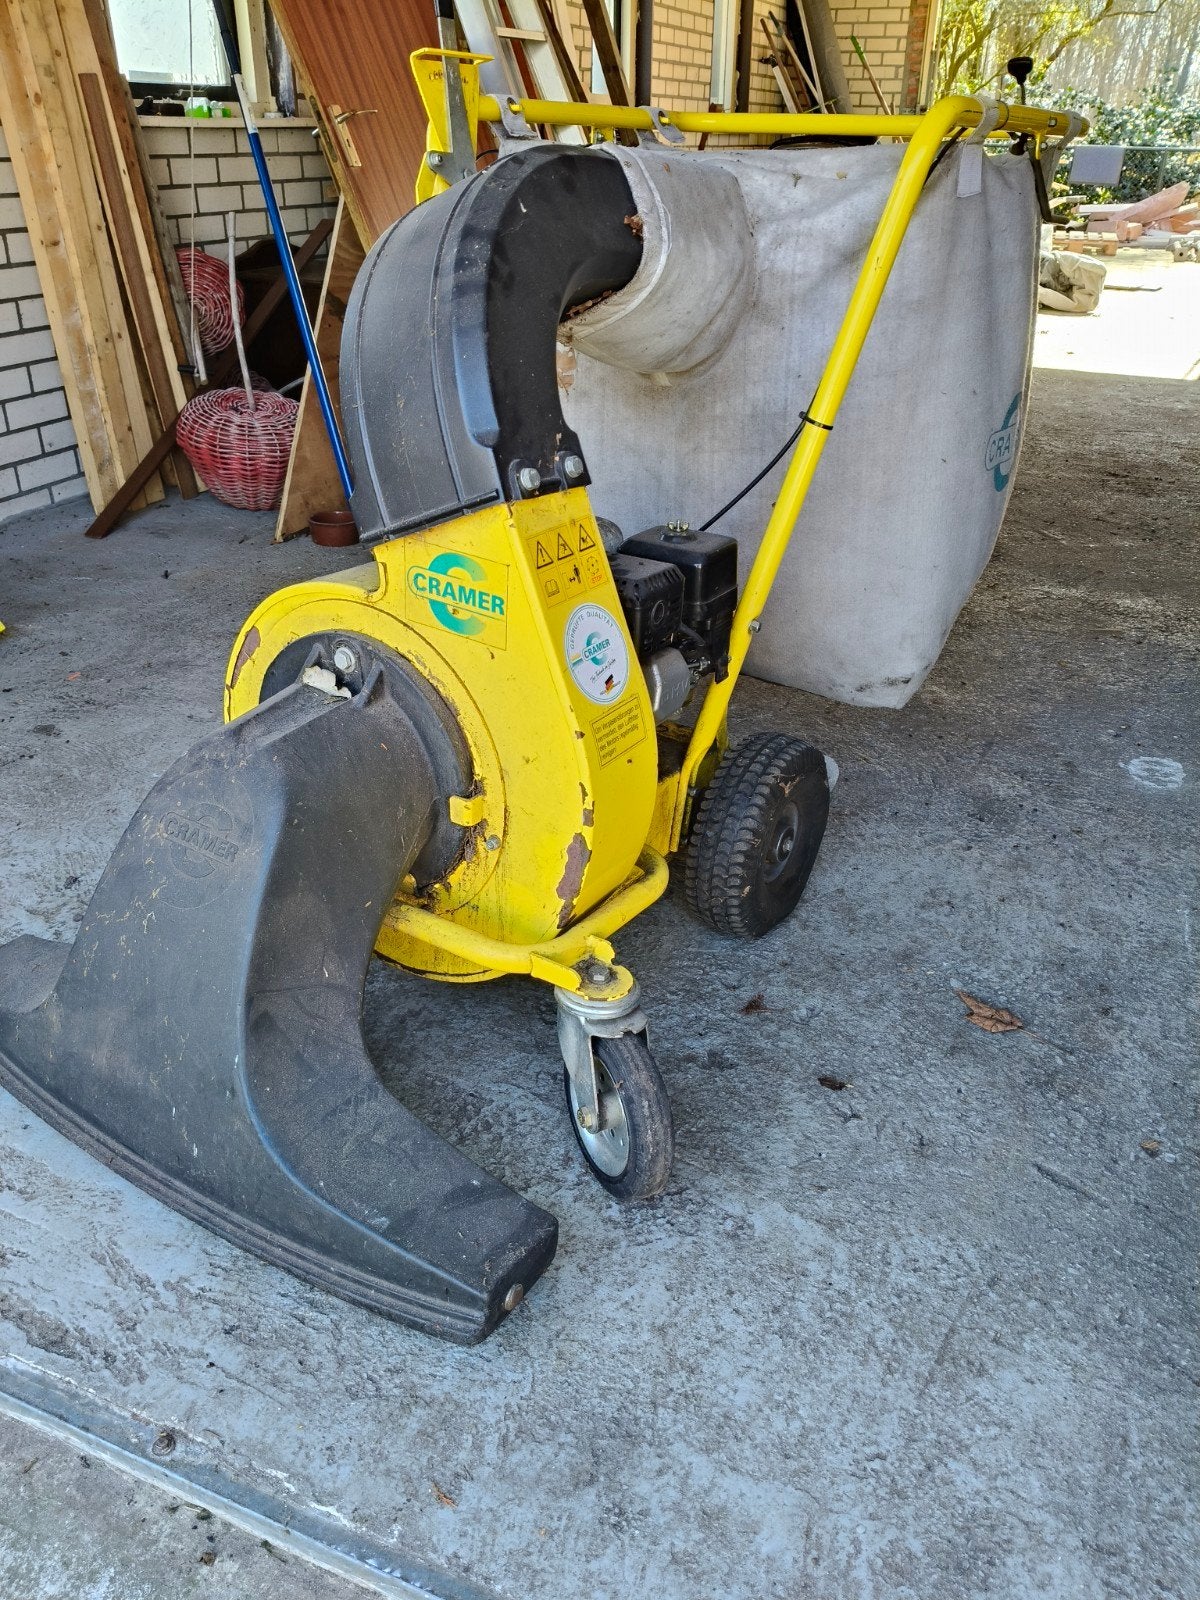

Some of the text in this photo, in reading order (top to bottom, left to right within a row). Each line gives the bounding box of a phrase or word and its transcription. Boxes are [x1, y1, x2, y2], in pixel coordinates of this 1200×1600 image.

[413, 572, 505, 616] CRAMER
[583, 638, 611, 659] CRAMER
[166, 817, 239, 862] CRAMER
